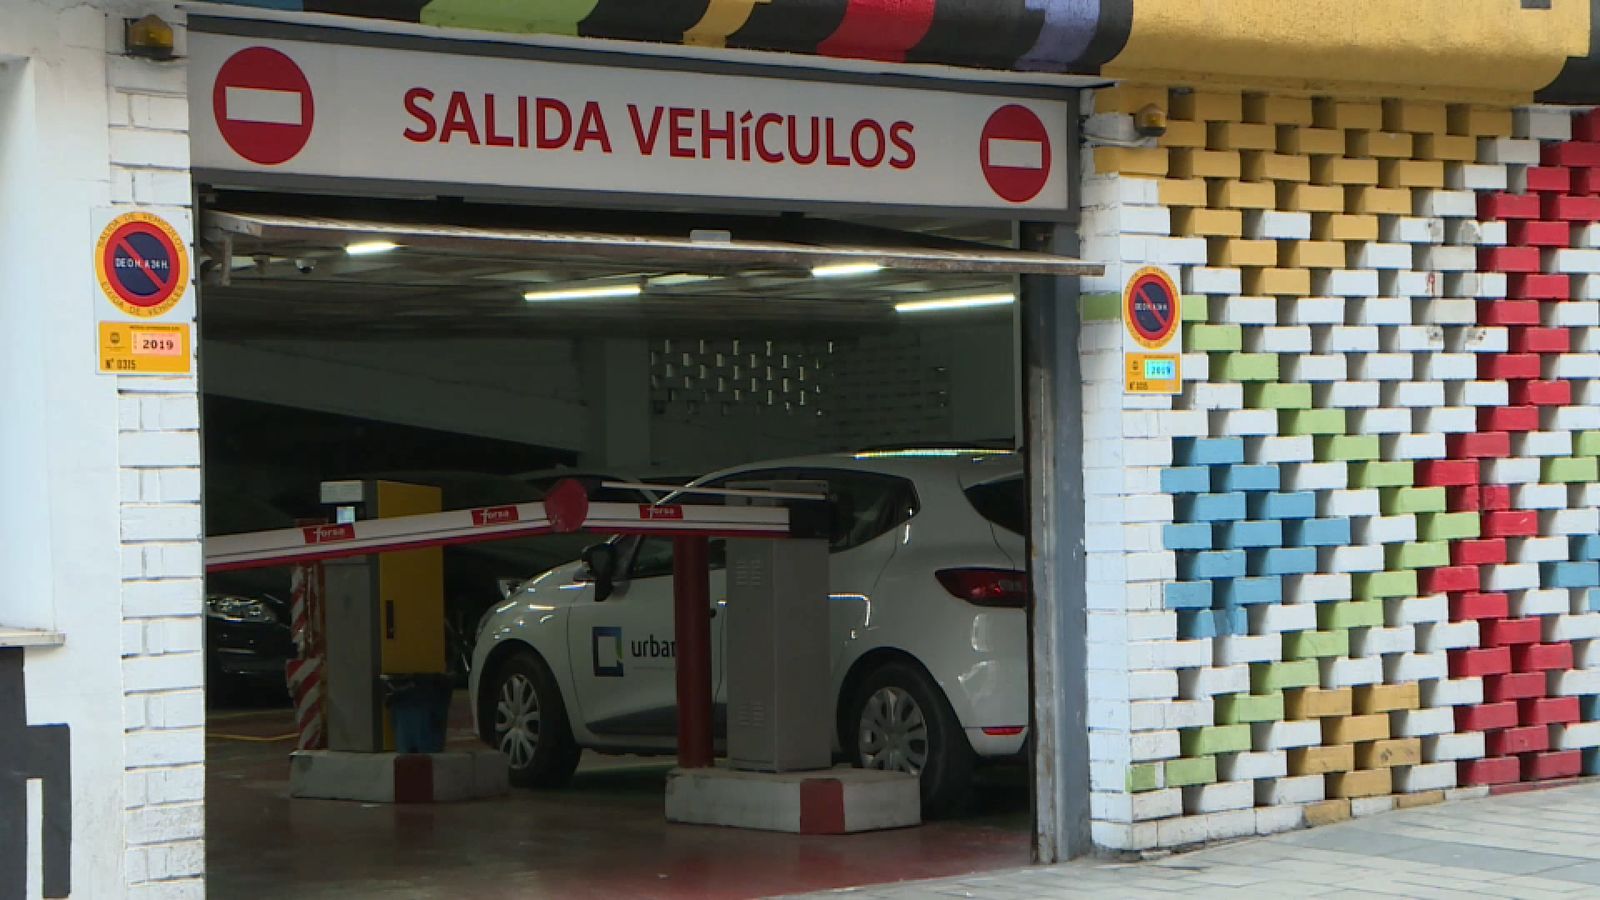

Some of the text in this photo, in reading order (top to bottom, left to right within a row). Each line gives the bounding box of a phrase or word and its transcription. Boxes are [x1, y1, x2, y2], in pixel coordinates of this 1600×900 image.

[402, 87, 612, 153] SALIDA
[115, 257, 127, 268] DE
[142, 339, 174, 351] 2019
[116, 359, 136, 371] 0315
